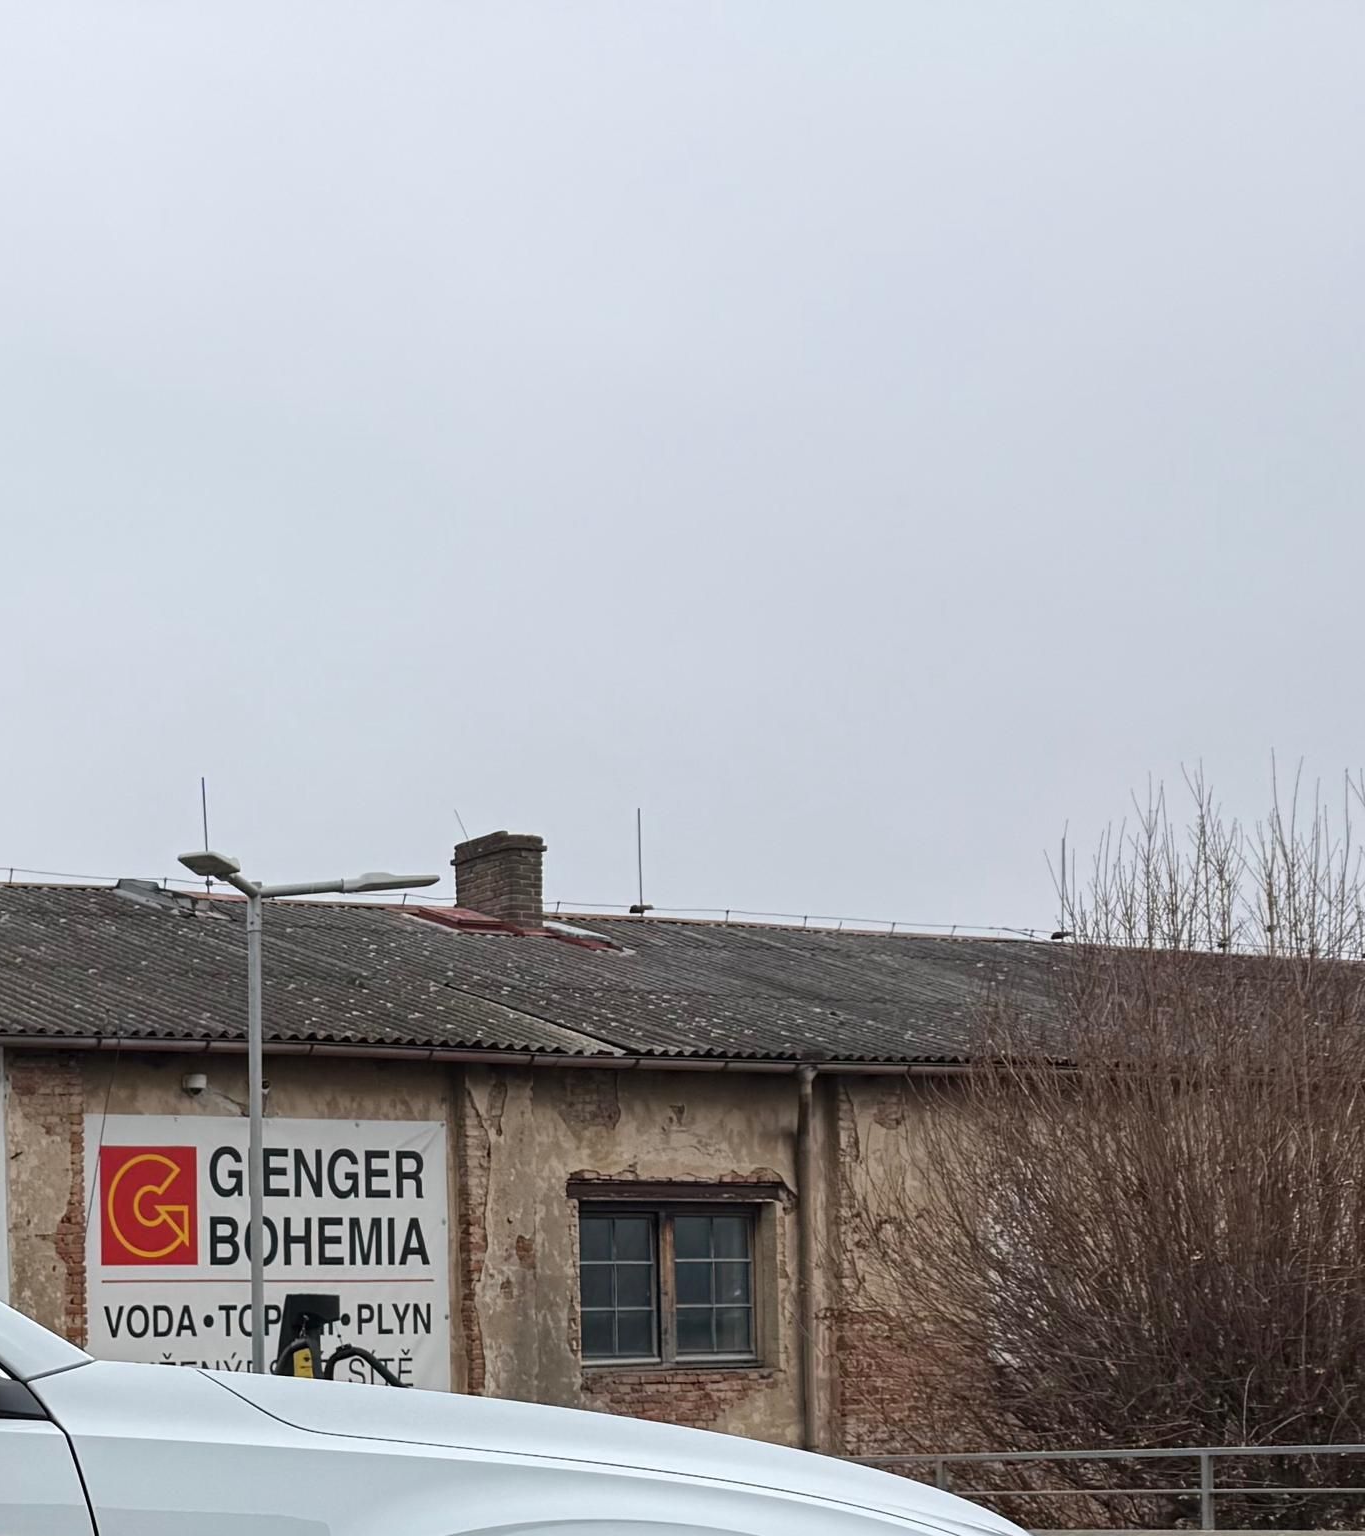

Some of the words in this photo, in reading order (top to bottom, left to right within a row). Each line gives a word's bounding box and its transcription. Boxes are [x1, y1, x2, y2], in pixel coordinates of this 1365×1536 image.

[209, 1146, 424, 1198] GENGER
[210, 1216, 430, 1266] BOHEMIA
[104, 1305, 197, 1337] VODA
[219, 1304, 333, 1336] TOP
[357, 1303, 432, 1335] PLYN
